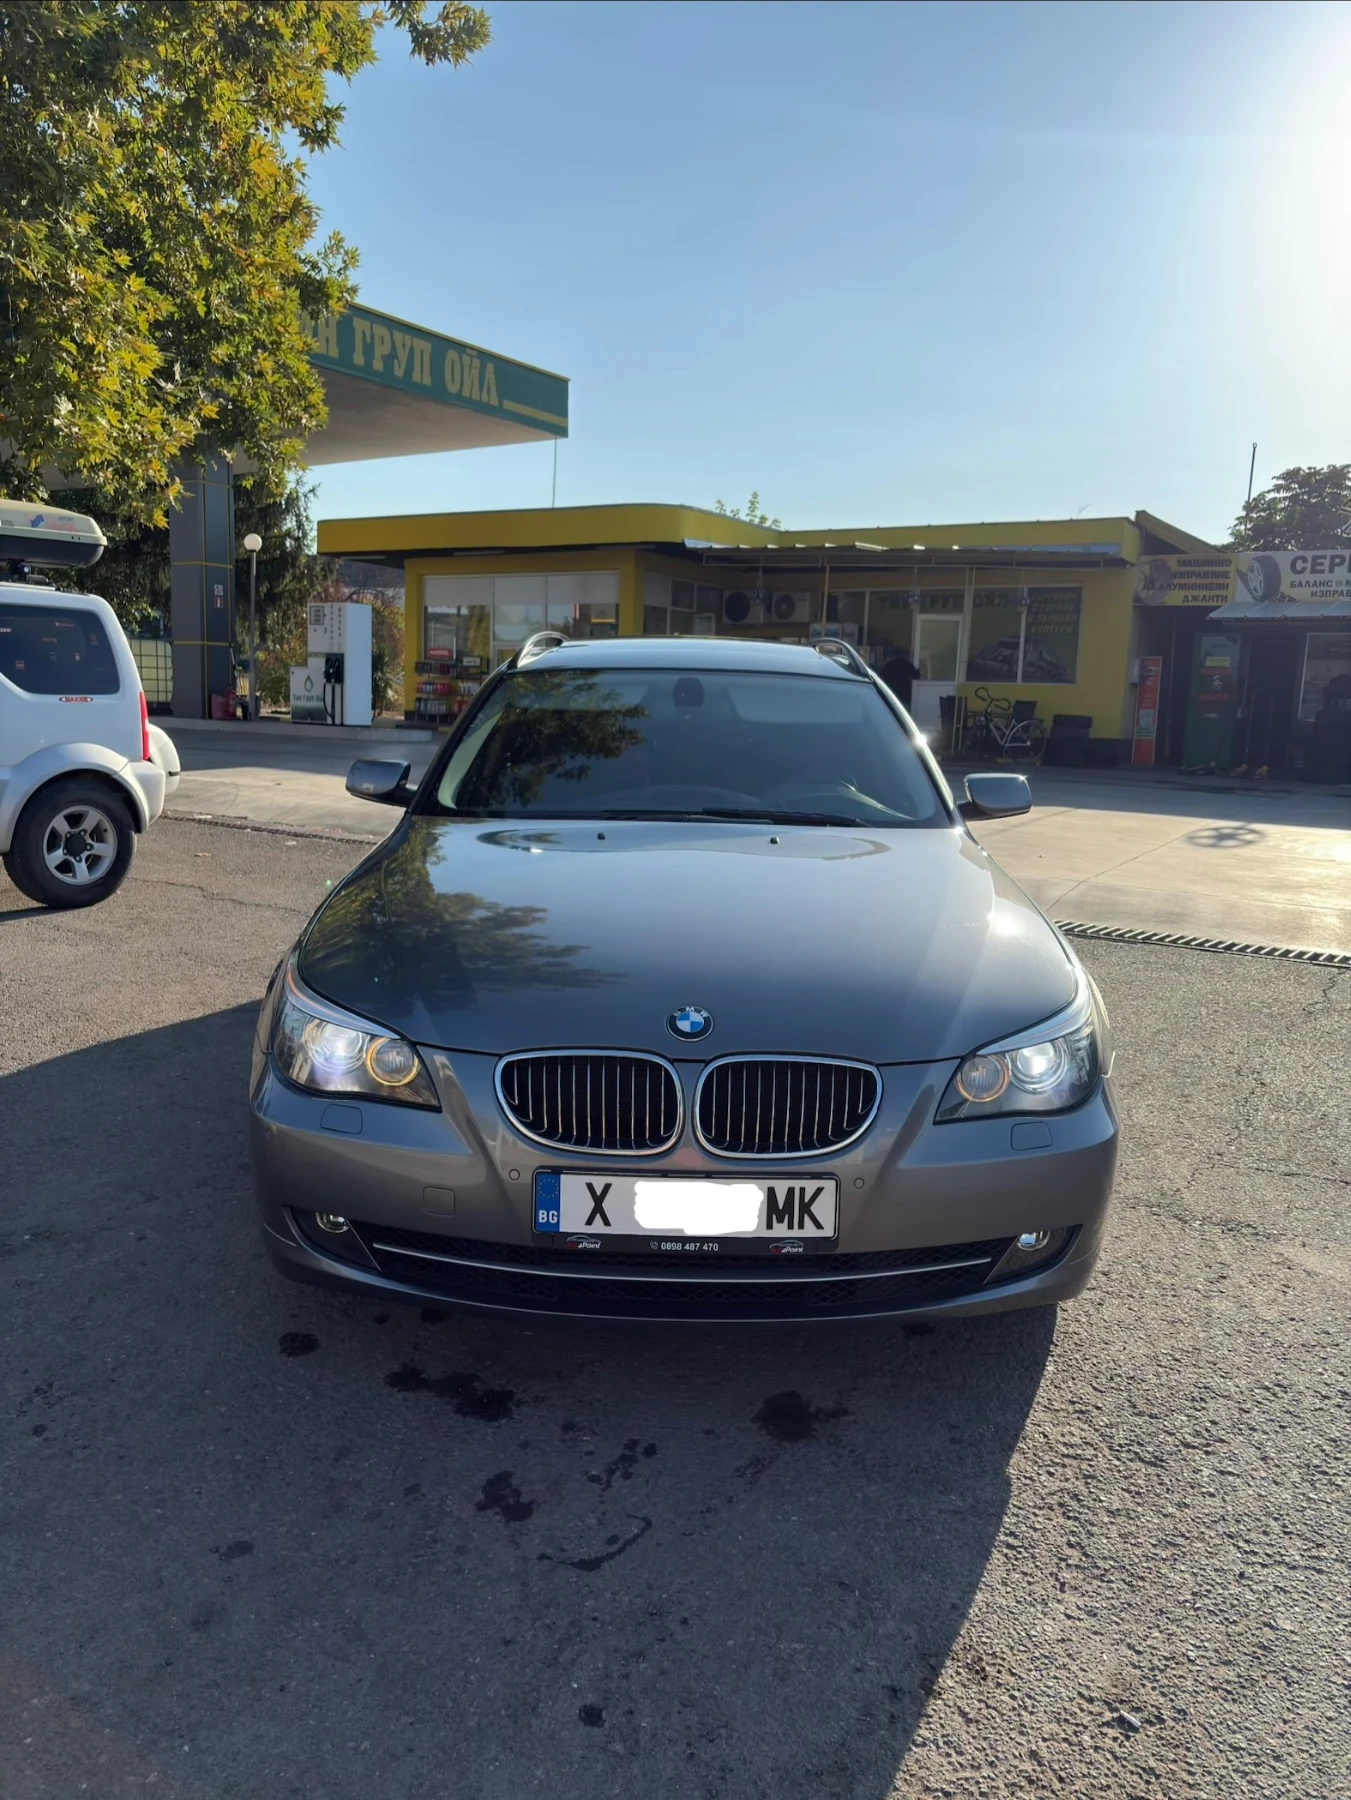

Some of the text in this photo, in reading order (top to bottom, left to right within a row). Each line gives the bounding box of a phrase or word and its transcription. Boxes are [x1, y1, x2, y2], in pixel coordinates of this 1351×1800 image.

[352, 316, 432, 386] ГРУП
[444, 348, 499, 407] ОЙЛ
[1176, 557, 1232, 568] МАШИННО
[1290, 554, 1351, 575] СЕР
[1171, 570, 1231, 580] ИЗПРАВЯНЕ
[1290, 580, 1333, 589] БАЛАНС
[1182, 594, 1229, 604] ДЖАНТИ
[673, 1006, 709, 1018] BMW
[538, 1182, 825, 1230] BG X MK
[661, 1242, 719, 1252] 0898 487 470
